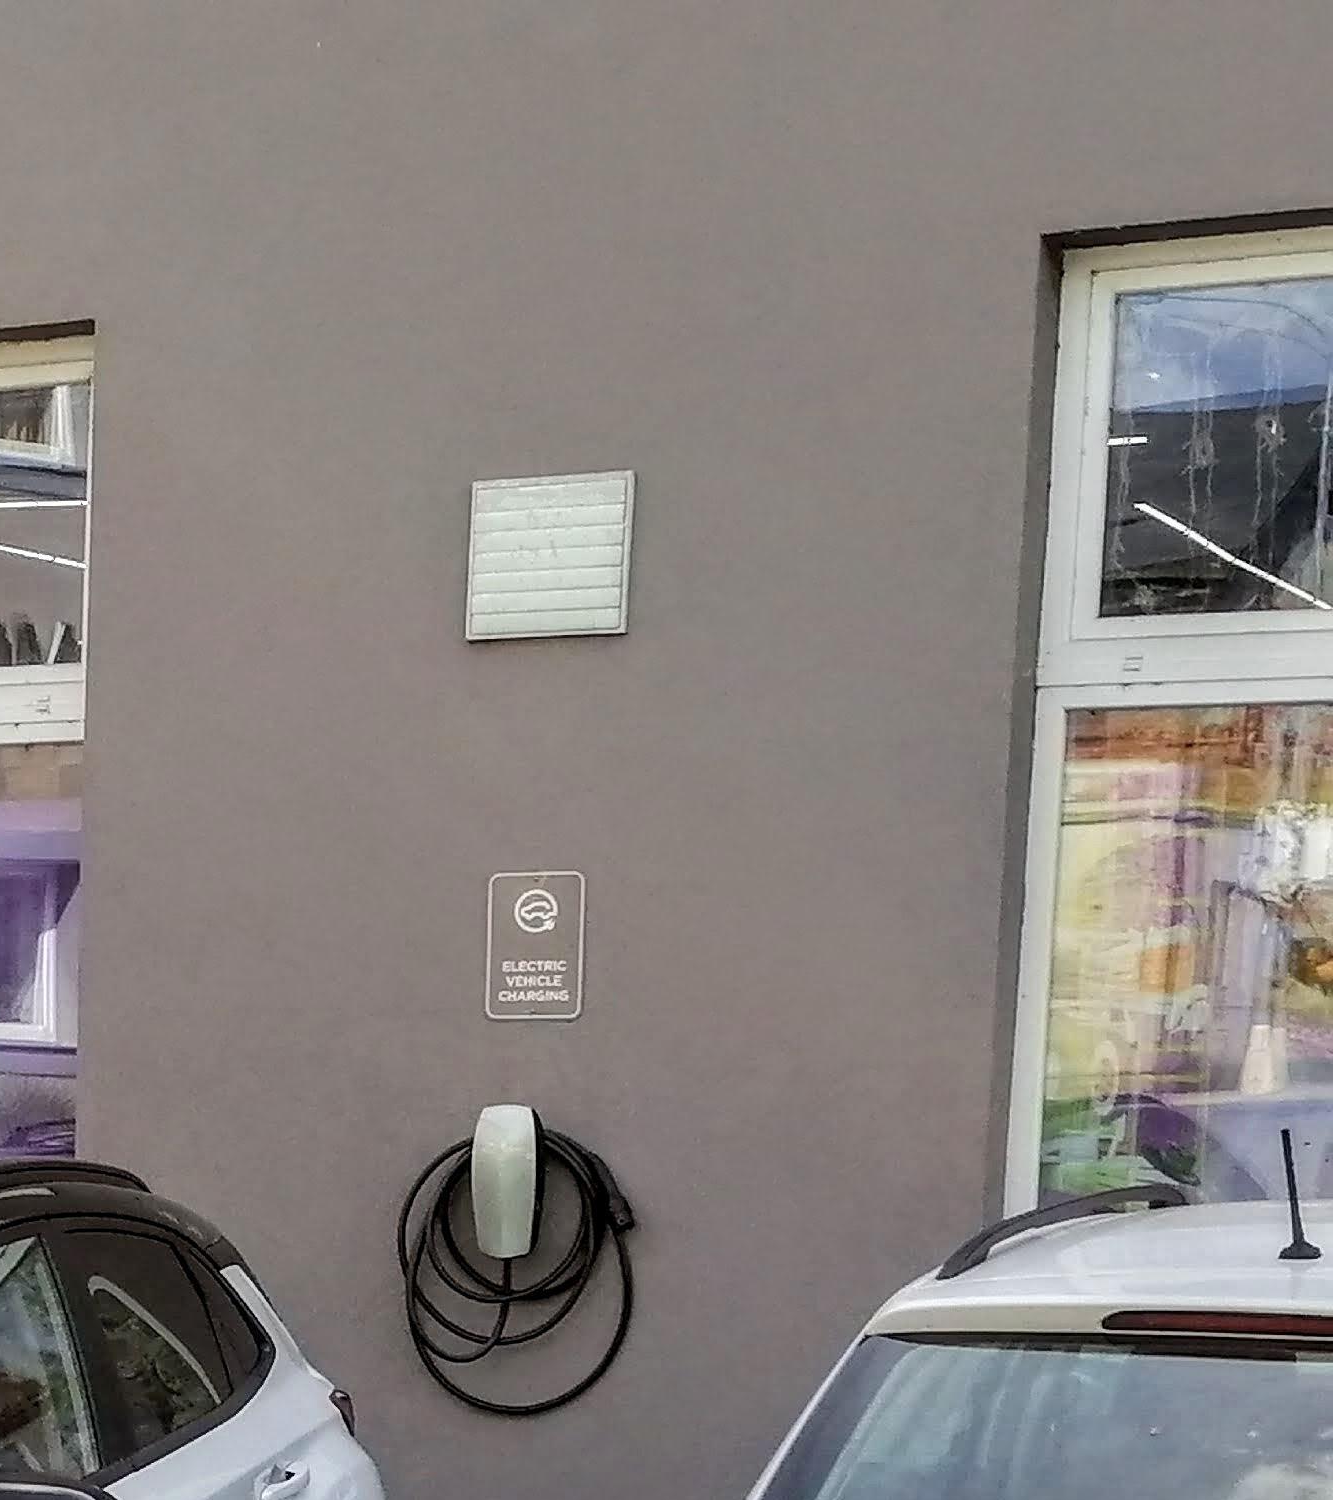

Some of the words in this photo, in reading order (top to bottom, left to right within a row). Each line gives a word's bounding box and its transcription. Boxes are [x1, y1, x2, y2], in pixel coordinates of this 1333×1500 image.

[501, 960, 568, 973] ELECTRIC
[505, 974, 564, 988] VEHICLE
[498, 989, 570, 1003] CHARGING
